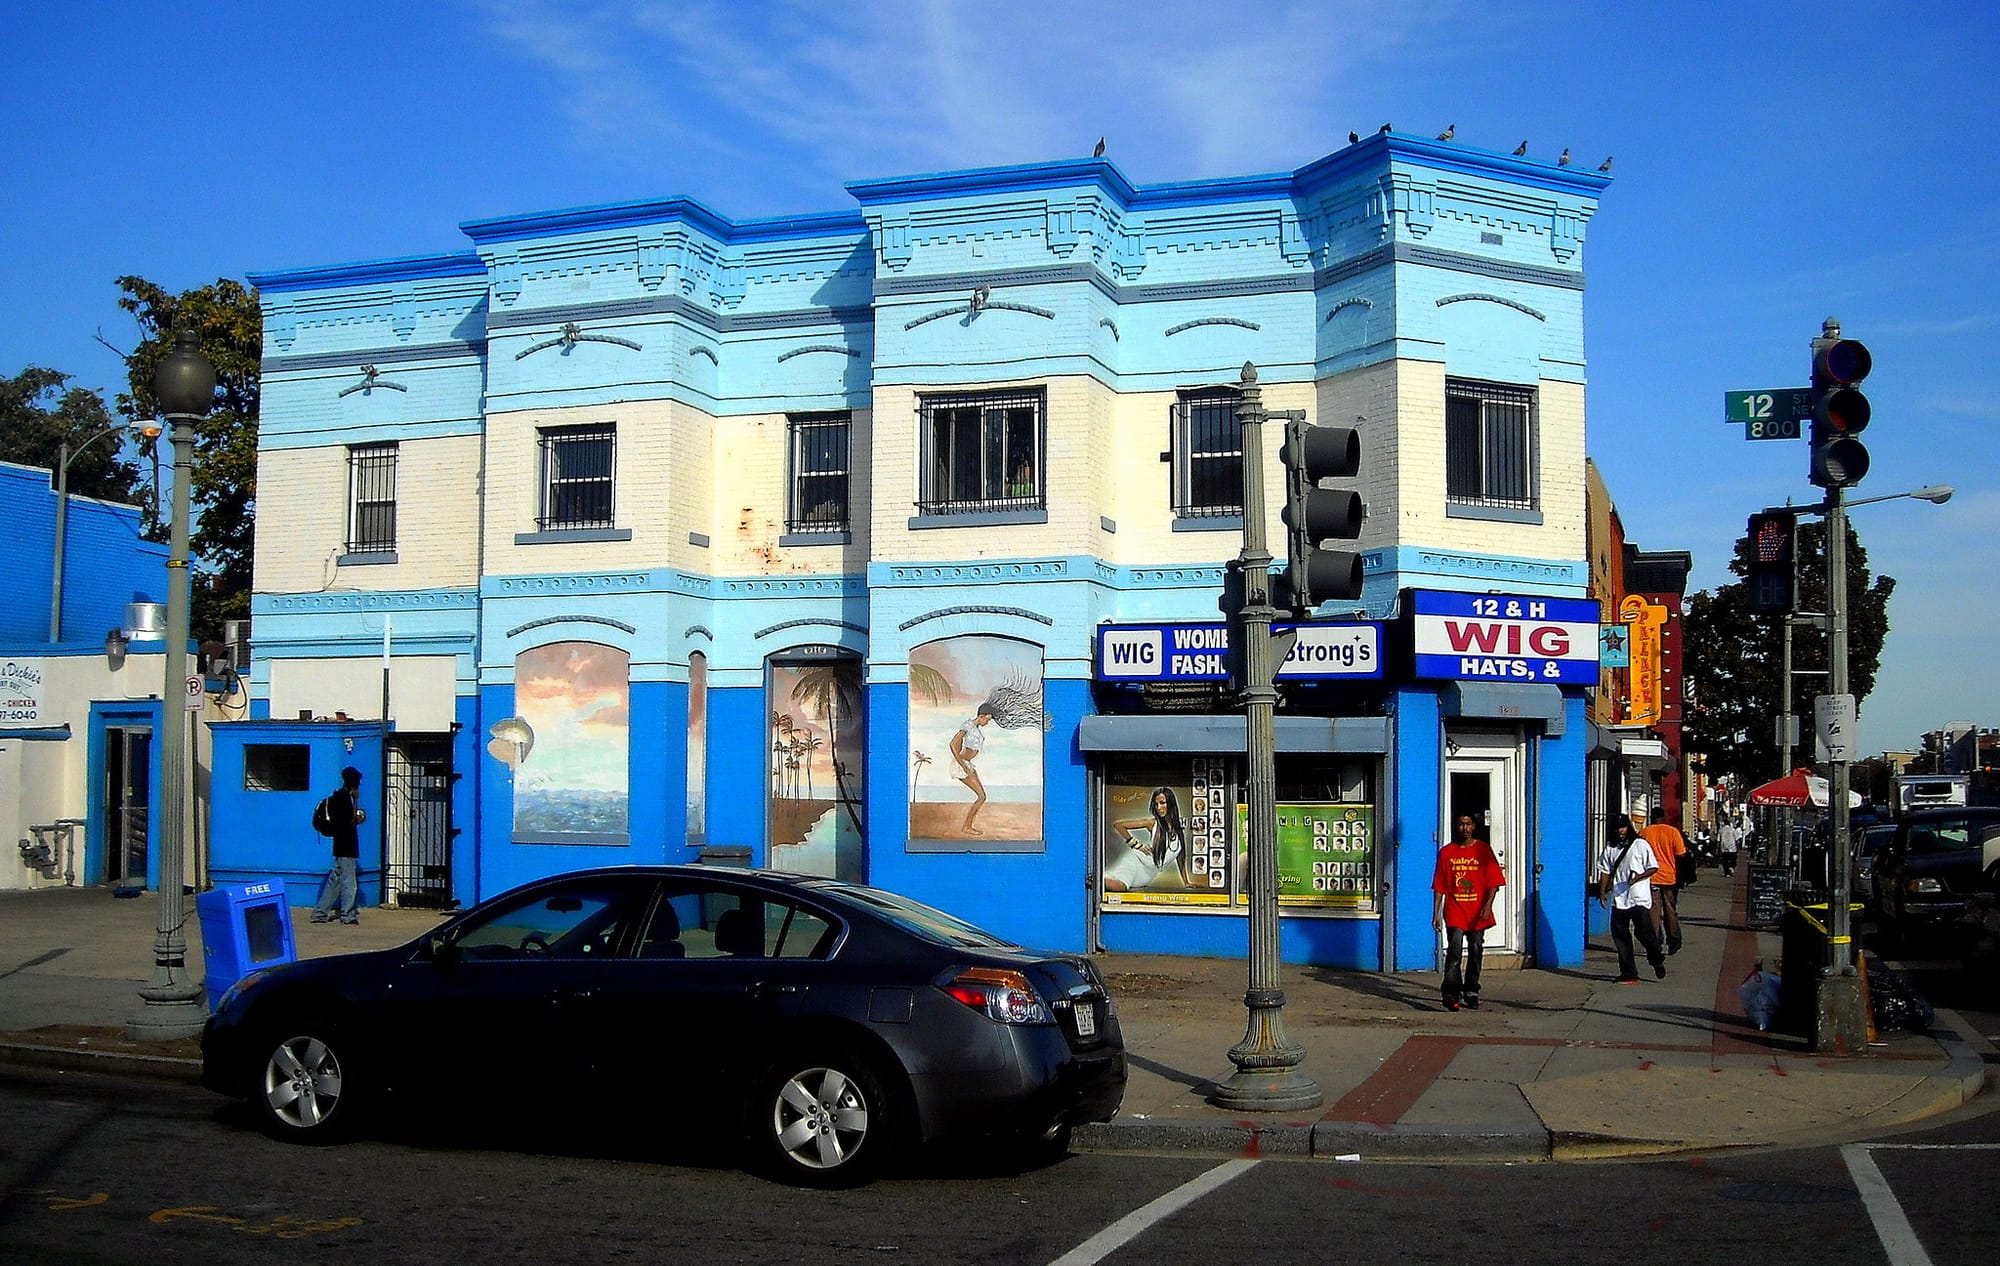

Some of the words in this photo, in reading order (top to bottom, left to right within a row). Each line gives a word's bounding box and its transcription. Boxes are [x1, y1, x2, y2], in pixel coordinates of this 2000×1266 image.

[1743, 394, 1774, 418] 12
[1793, 394, 1808, 404] ST
[1792, 406, 1809, 415] NE
[1751, 421, 1794, 437] 800
[1472, 599, 1499, 616] 12
[1505, 601, 1522, 617] &
[1530, 602, 1546, 618] H
[1444, 621, 1570, 656] WIG
[1112, 642, 1154, 664] WIG
[1460, 658, 1536, 680] HATS,
[1543, 661, 1561, 678] &
[245, 884, 271, 896] FREE
